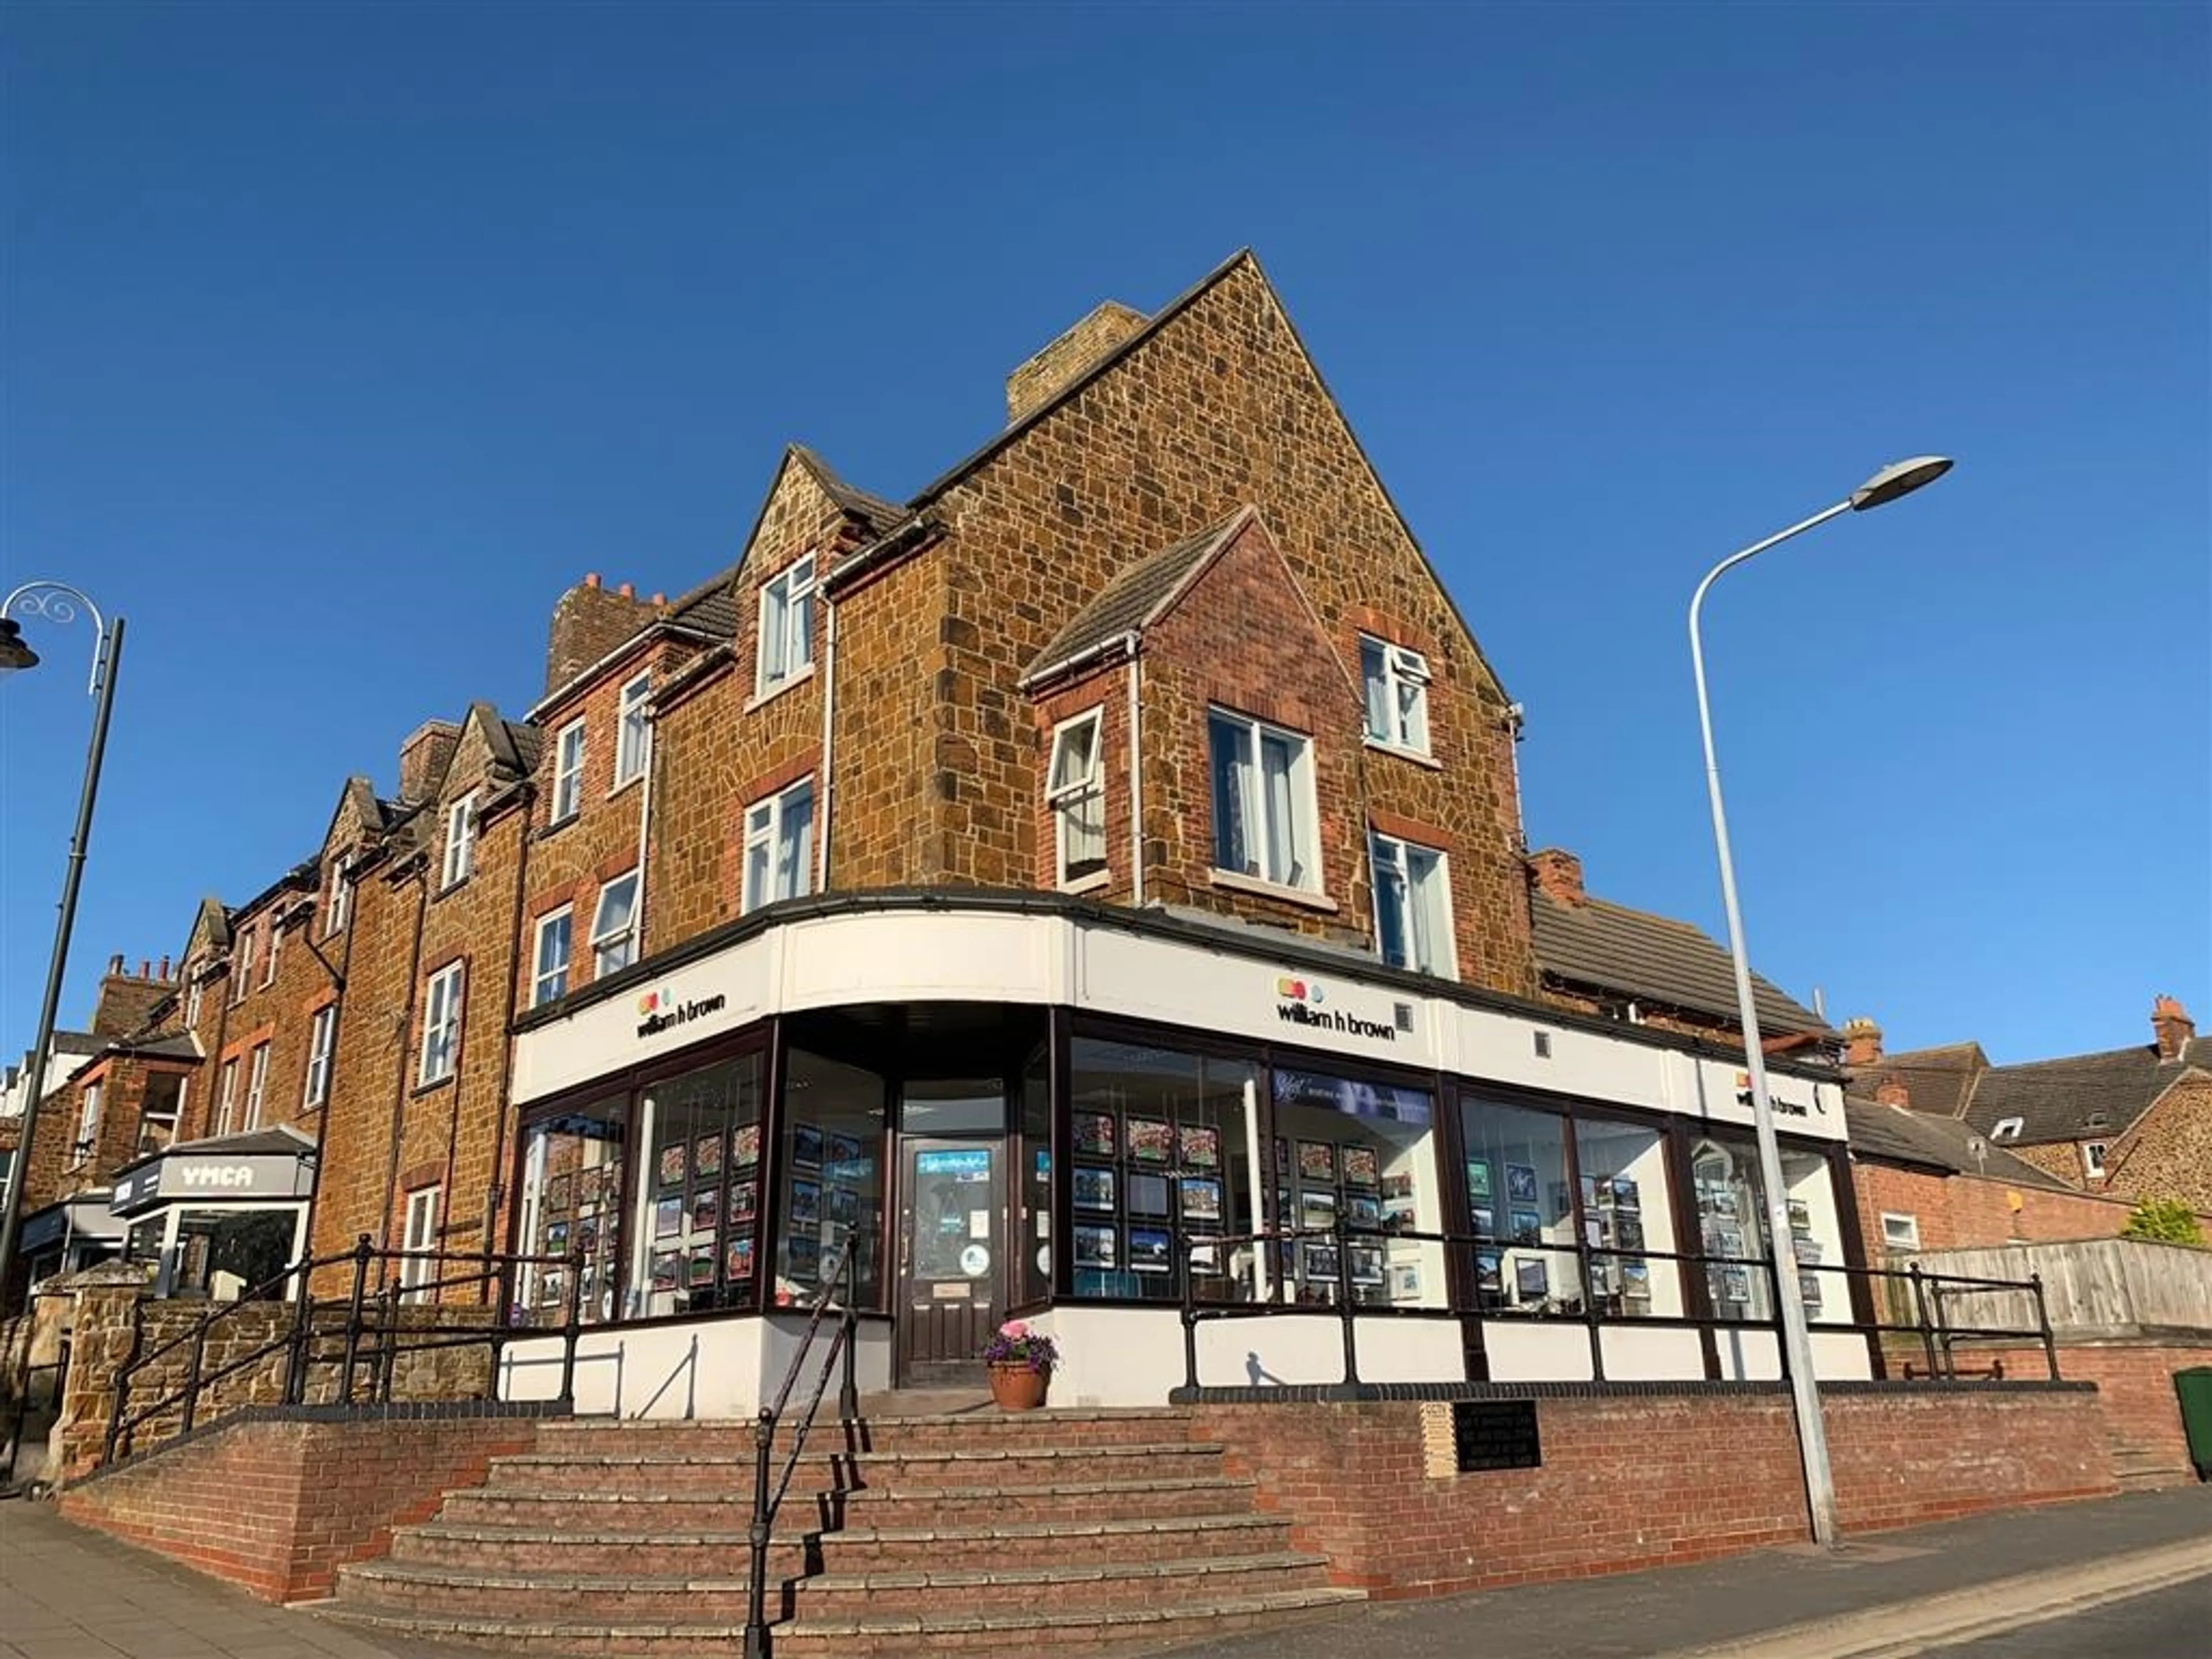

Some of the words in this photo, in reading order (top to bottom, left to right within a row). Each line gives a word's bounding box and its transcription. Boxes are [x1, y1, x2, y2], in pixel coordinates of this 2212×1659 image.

[677, 1004, 685, 1024] h
[687, 994, 725, 1022] brown
[1277, 1002, 1332, 1029] william
[1335, 1010, 1346, 1032] h
[1347, 1012, 1395, 1041] brown
[1778, 1097, 1807, 1116] brown
[183, 1165, 253, 1187] YMCA
